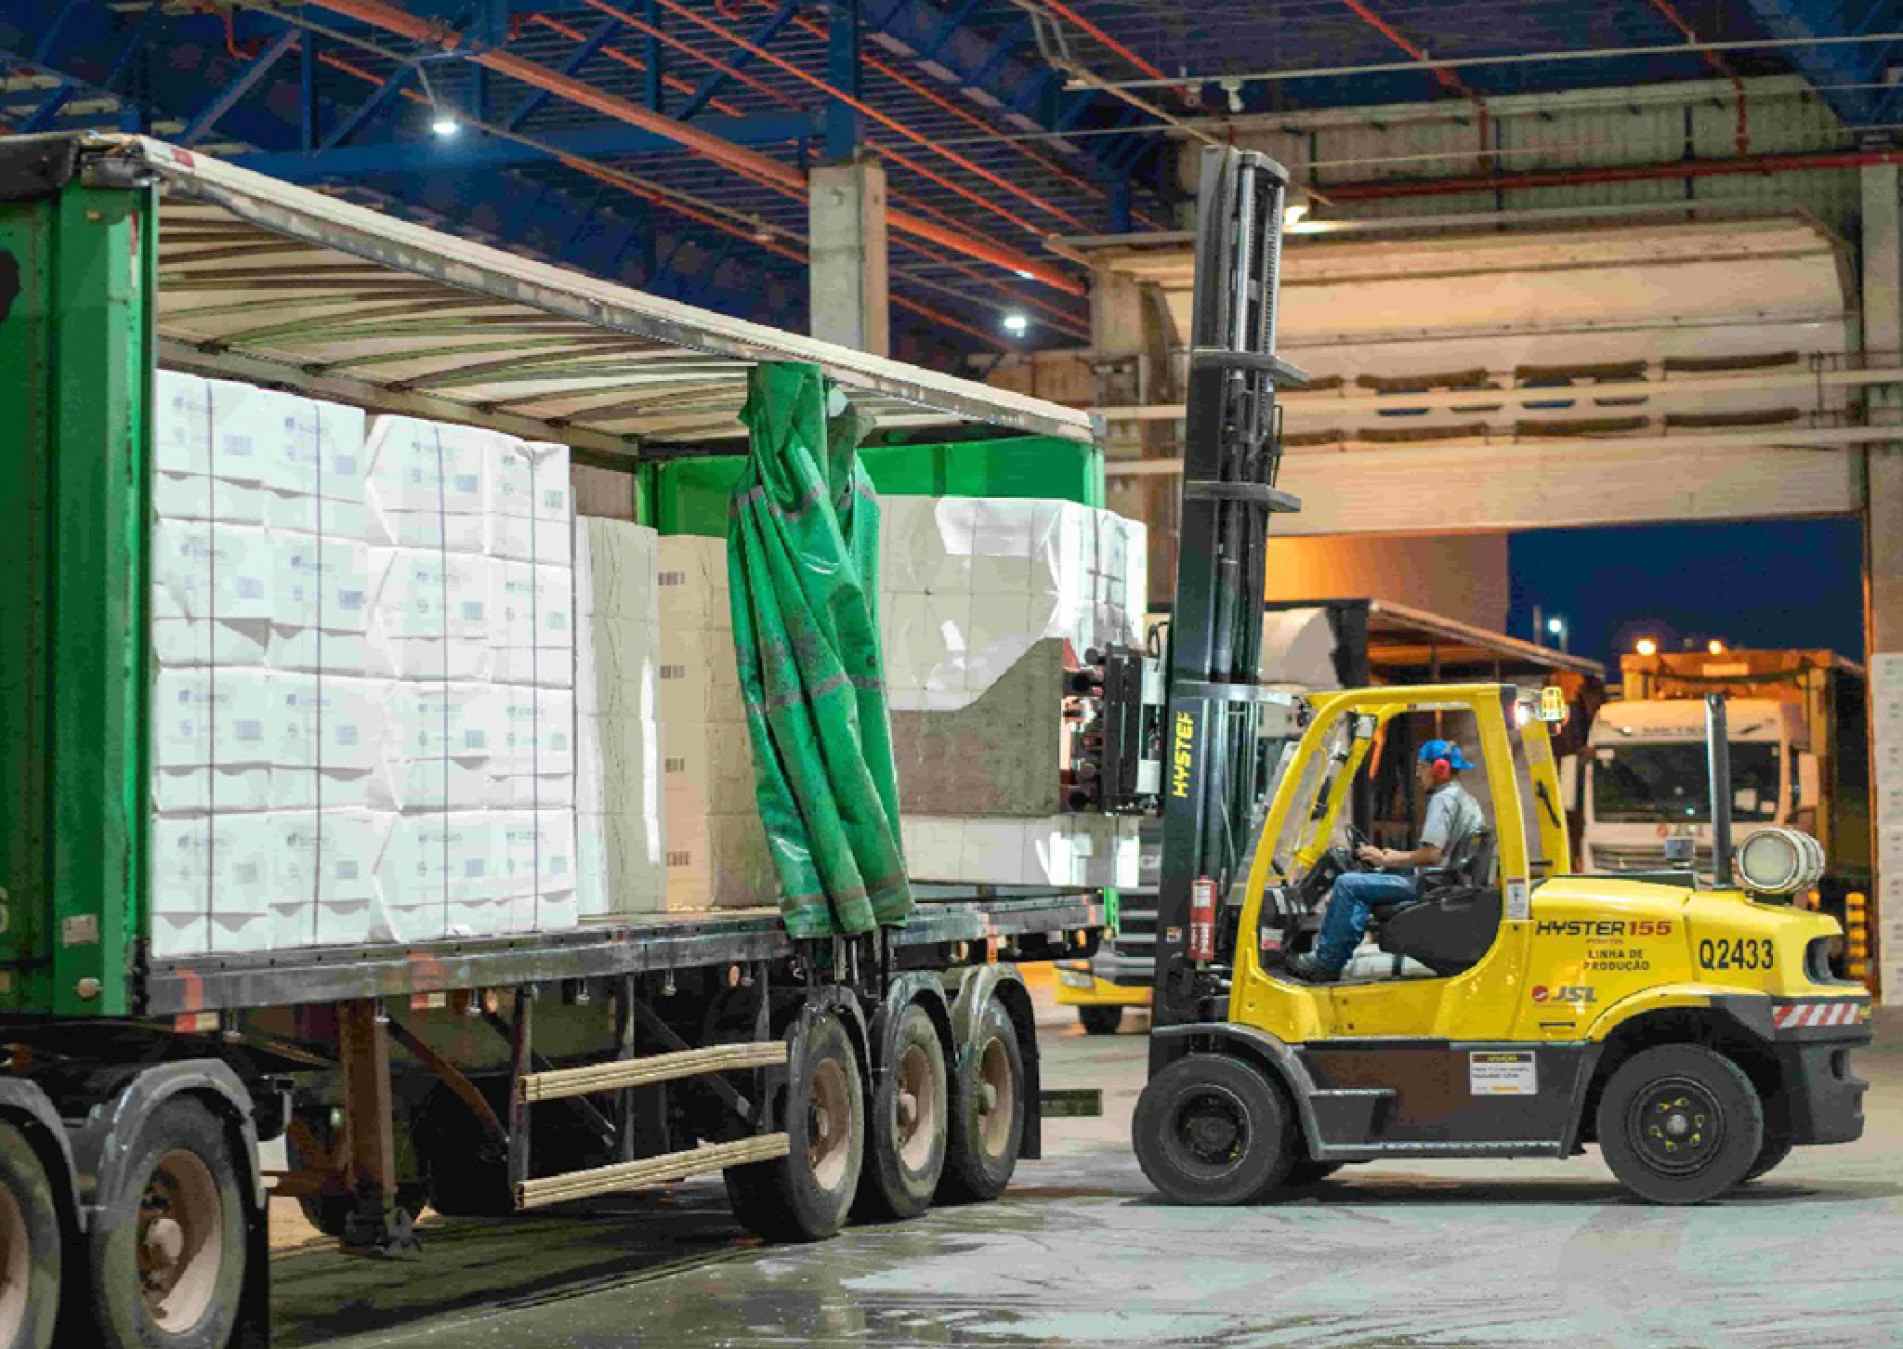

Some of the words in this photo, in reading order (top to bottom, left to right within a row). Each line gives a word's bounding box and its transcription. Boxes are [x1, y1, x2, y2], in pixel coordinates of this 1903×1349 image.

[1535, 920, 1626, 936] HYSTER
[1629, 920, 1673, 936] 155
[1588, 949, 1625, 960] LINHA
[1629, 949, 1643, 960] DE
[1699, 938, 1774, 972] Q2433
[1584, 960, 1650, 971] PRODUÇÃO
[1552, 985, 1598, 1003] JSL
